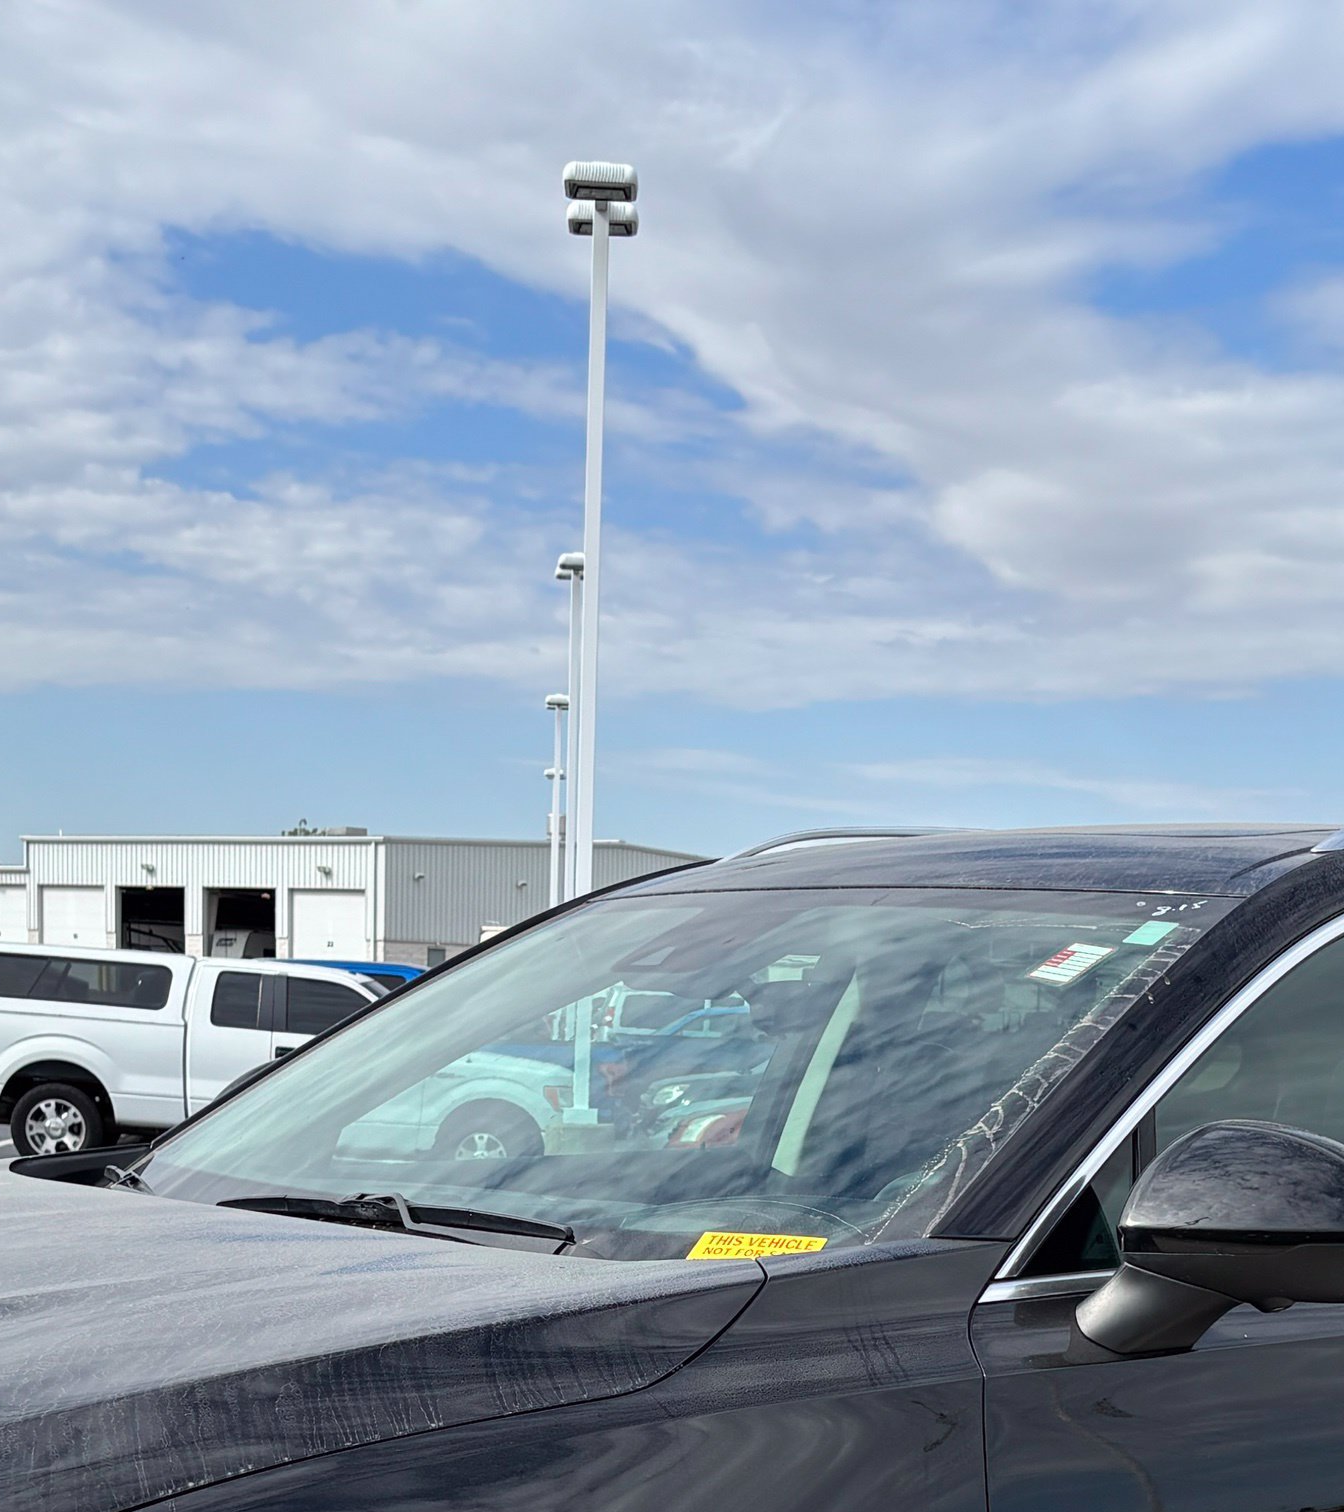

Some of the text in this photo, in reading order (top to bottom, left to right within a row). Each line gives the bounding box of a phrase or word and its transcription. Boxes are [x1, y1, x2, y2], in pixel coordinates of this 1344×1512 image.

[707, 1235, 818, 1251] THIS VEHICLE
[702, 1247, 733, 1256] NOT
[735, 1248, 765, 1258] FOR
